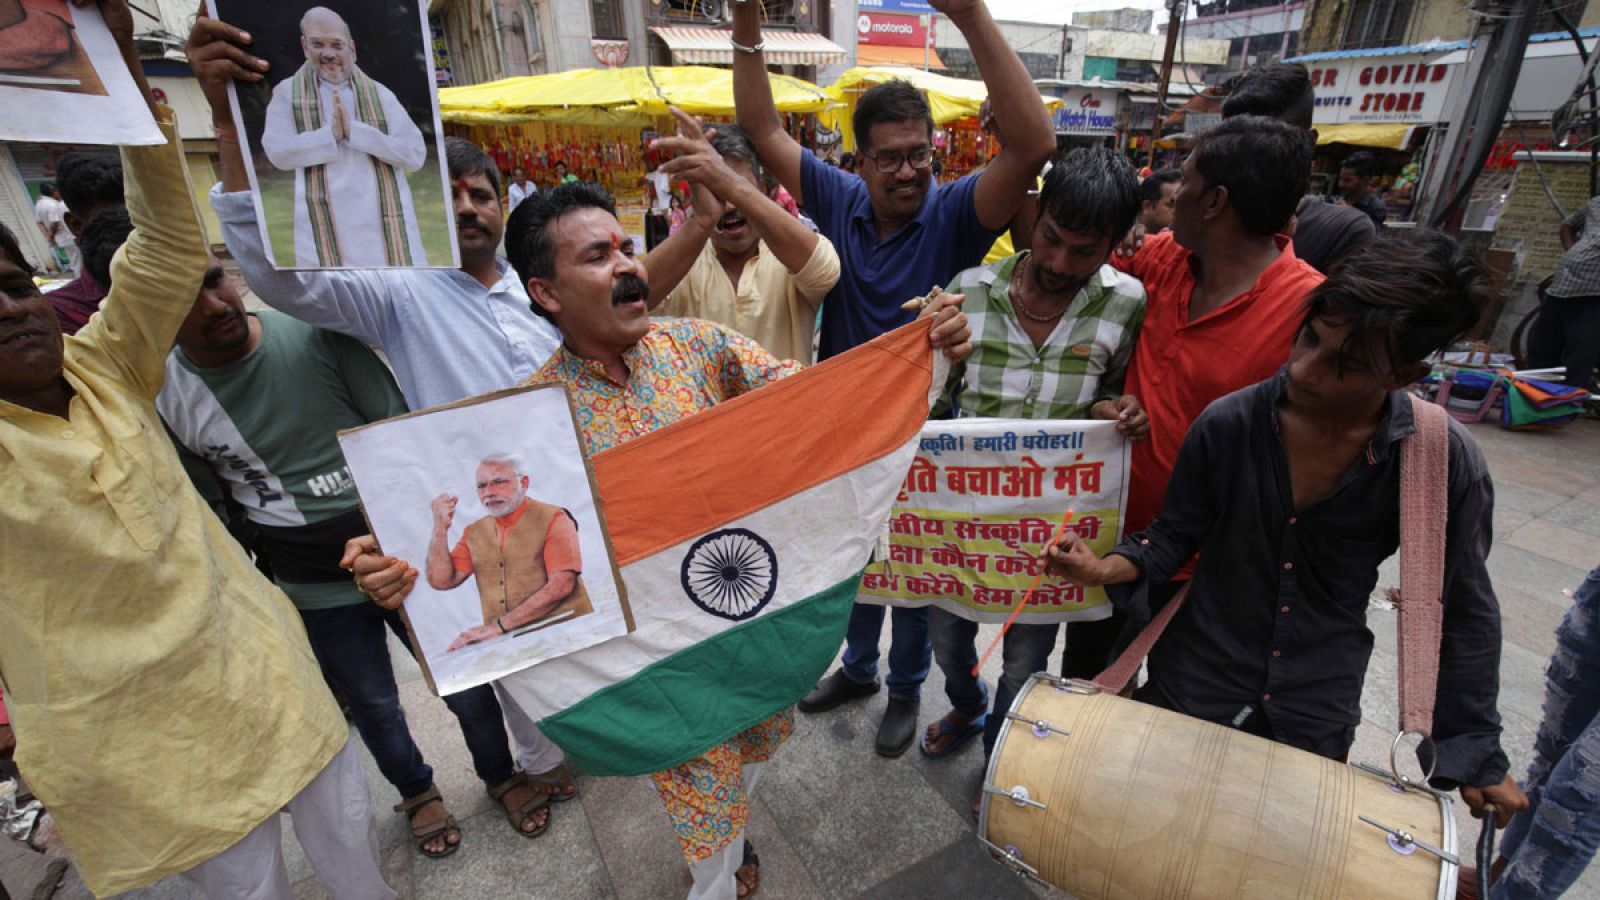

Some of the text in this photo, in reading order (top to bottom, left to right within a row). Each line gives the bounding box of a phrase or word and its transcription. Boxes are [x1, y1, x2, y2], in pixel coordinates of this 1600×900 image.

[872, 22, 913, 34] motorola
[1359, 63, 1449, 86] GOVIND
[1360, 92, 1425, 112] STORE
[1087, 110, 1114, 128] House
[973, 431, 1017, 453] हमारी
[944, 459, 1047, 498] बचाओ
[1053, 453, 1105, 497] मंच
[931, 542, 989, 573] कौन
